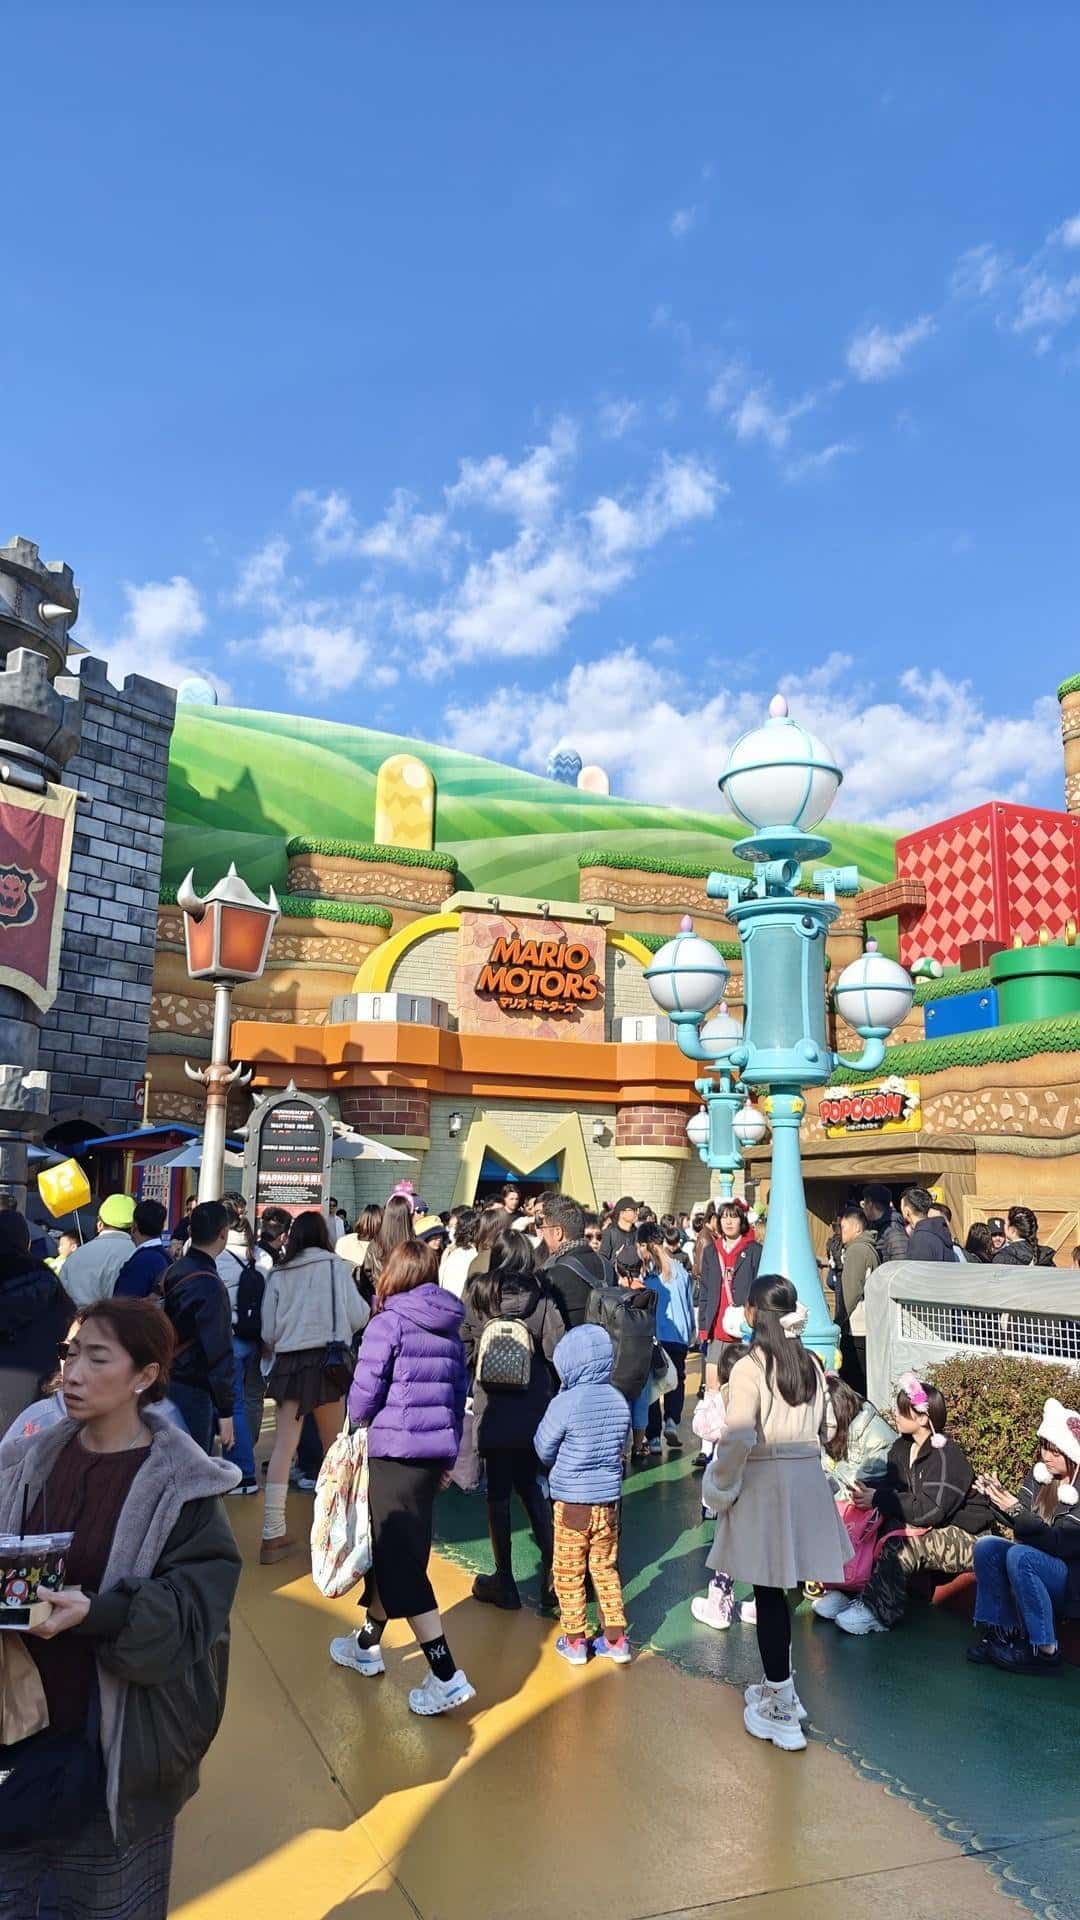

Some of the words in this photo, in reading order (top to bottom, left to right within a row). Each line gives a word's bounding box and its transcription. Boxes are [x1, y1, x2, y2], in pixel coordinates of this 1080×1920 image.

[490, 937, 590, 970] MARIO
[476, 965, 600, 1000] MOTORS
[819, 1093, 902, 1124] POPCORN
